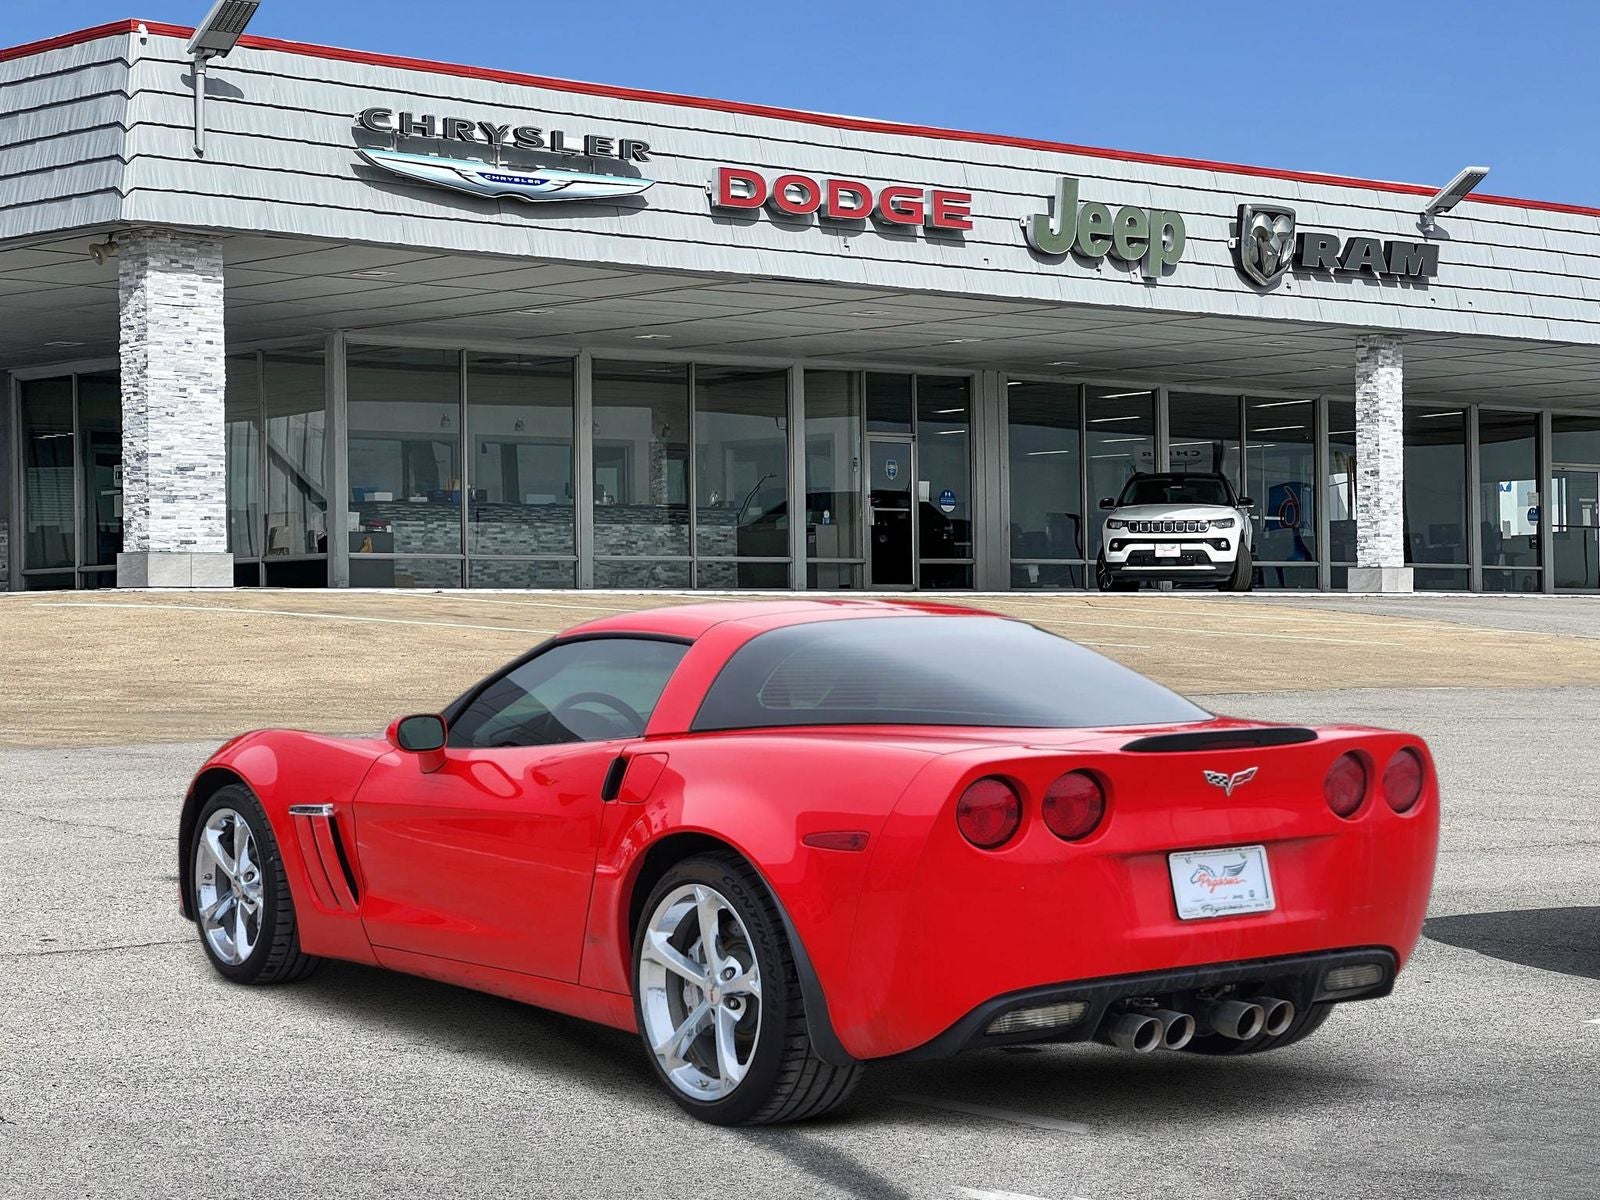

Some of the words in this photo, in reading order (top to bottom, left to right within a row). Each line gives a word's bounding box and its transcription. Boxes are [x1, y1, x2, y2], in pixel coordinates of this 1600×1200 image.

[356, 106, 651, 162] CHRYSLER
[484, 174, 541, 185] CHRYSLER
[712, 166, 974, 231] DODGE
[1027, 176, 1187, 278] Jeep
[1298, 231, 1440, 279] RAM
